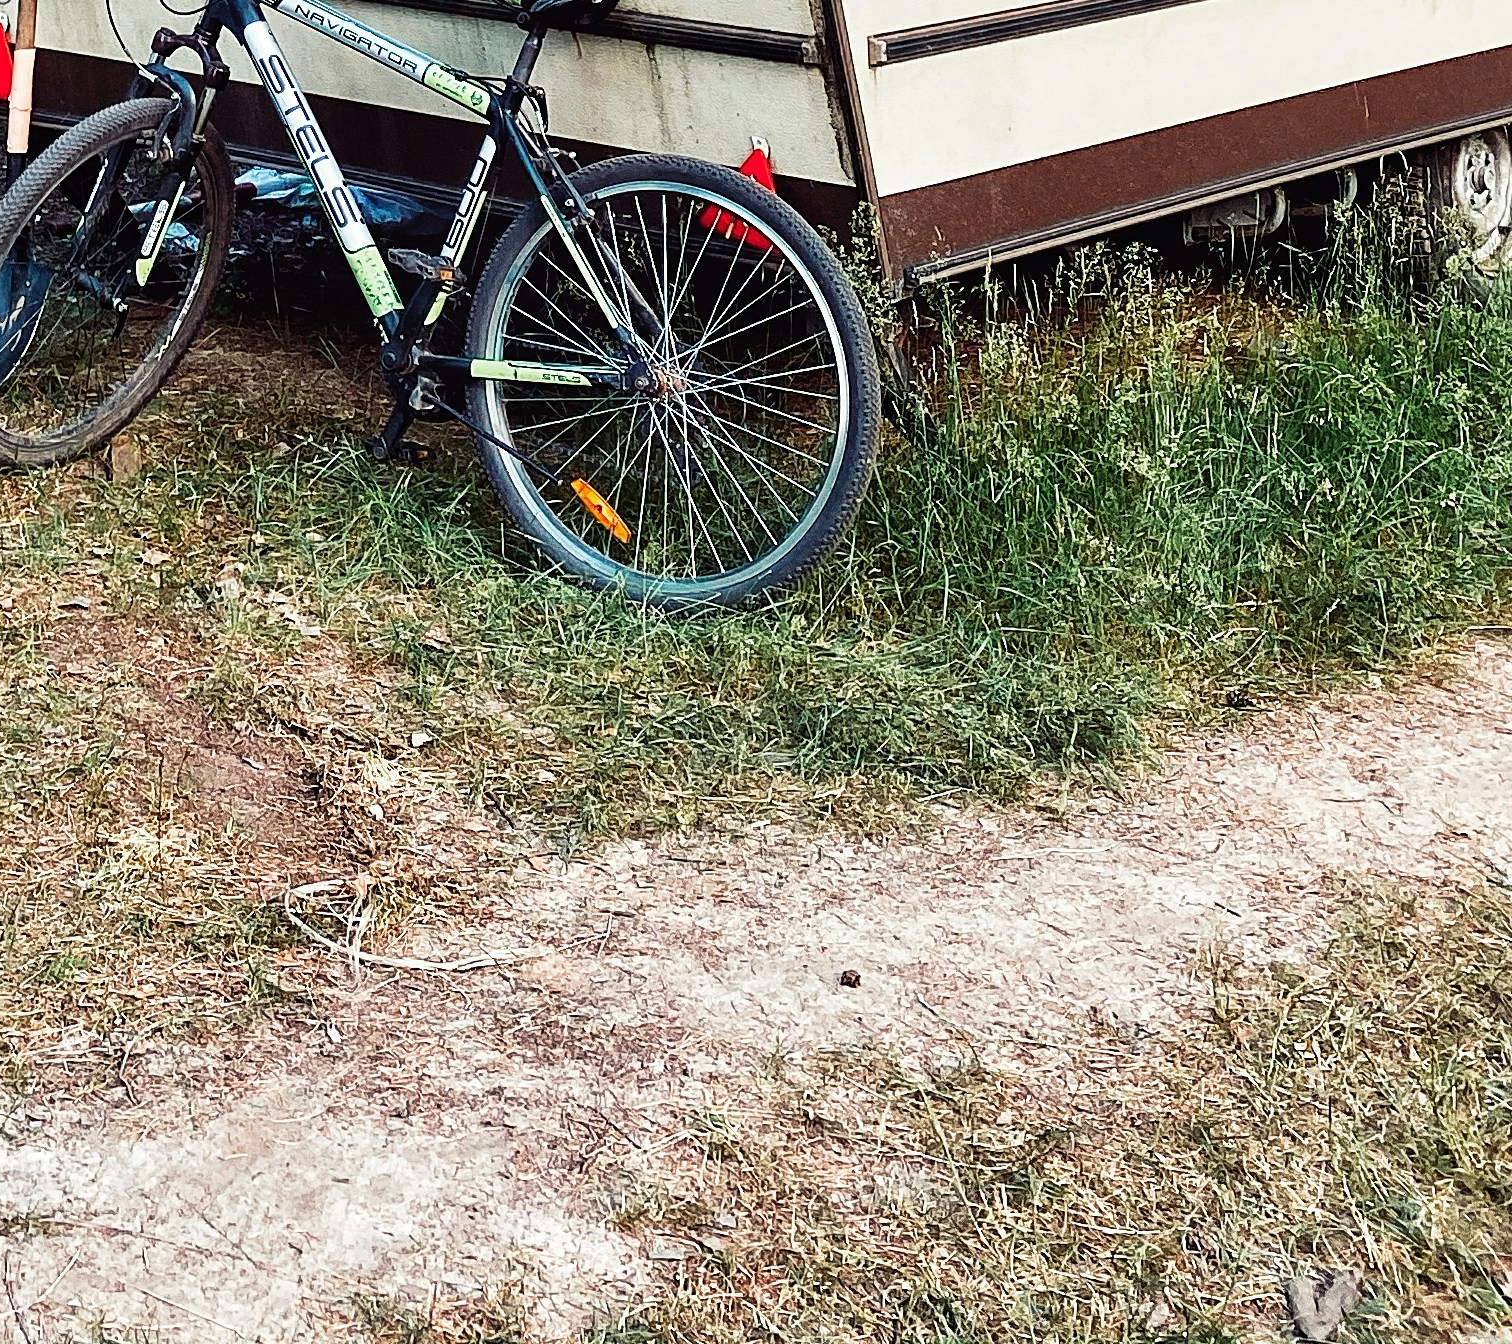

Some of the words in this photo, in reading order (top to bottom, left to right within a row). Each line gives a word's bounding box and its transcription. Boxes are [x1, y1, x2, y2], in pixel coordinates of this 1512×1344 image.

[295, 4, 418, 73] NAVIGATOR
[260, 54, 358, 227] STELS
[541, 373, 581, 384] STELS
